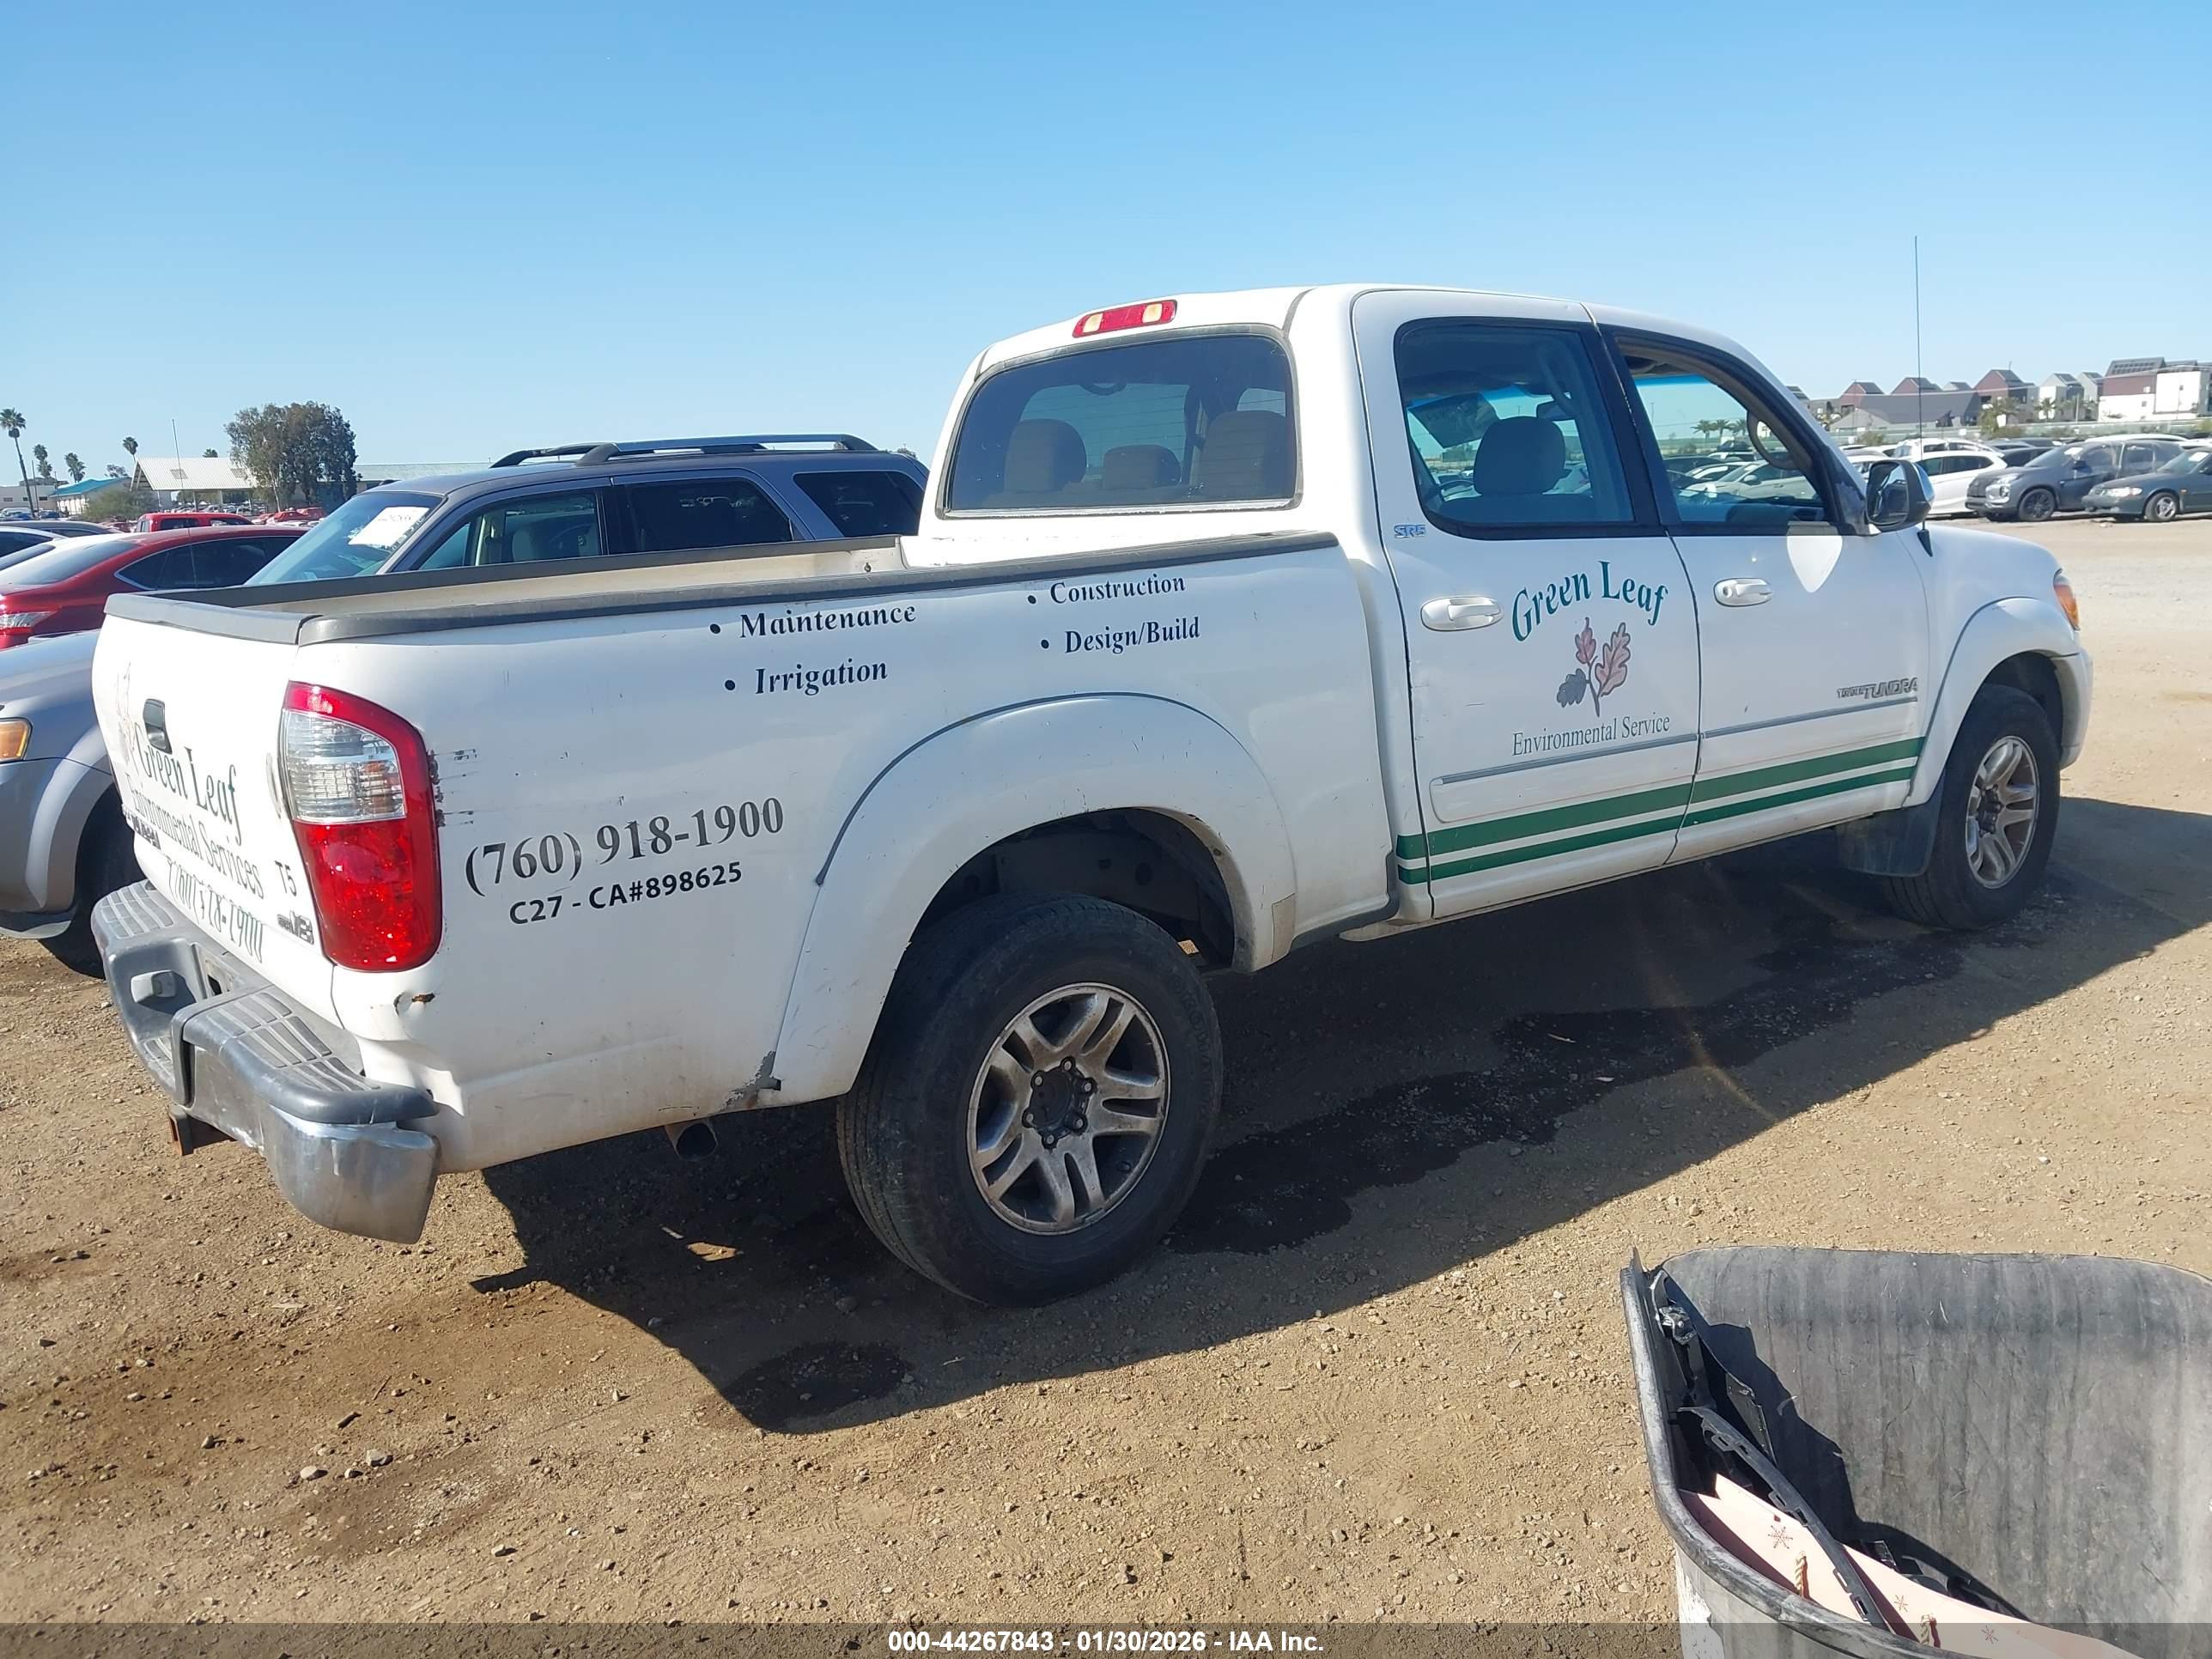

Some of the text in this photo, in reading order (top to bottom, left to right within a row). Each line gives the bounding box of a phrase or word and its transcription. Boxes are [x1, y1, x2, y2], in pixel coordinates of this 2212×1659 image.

[1394, 524, 1426, 538] SR5
[1050, 573, 1186, 605] Construction
[1512, 561, 1669, 642] Green Leaf
[739, 605, 917, 638] Maintenance
[1065, 617, 1200, 653] Design/Build
[756, 658, 888, 696] Irrigation
[1512, 714, 1670, 757] Environmental Service
[135, 721, 188, 800] Green
[184, 746, 242, 847] Leaf
[198, 820, 264, 899] Services
[465, 797, 783, 896] (760) 918-1900
[275, 860, 297, 896] T5
[509, 896, 562, 925] C27
[589, 861, 742, 908] CA#898625
